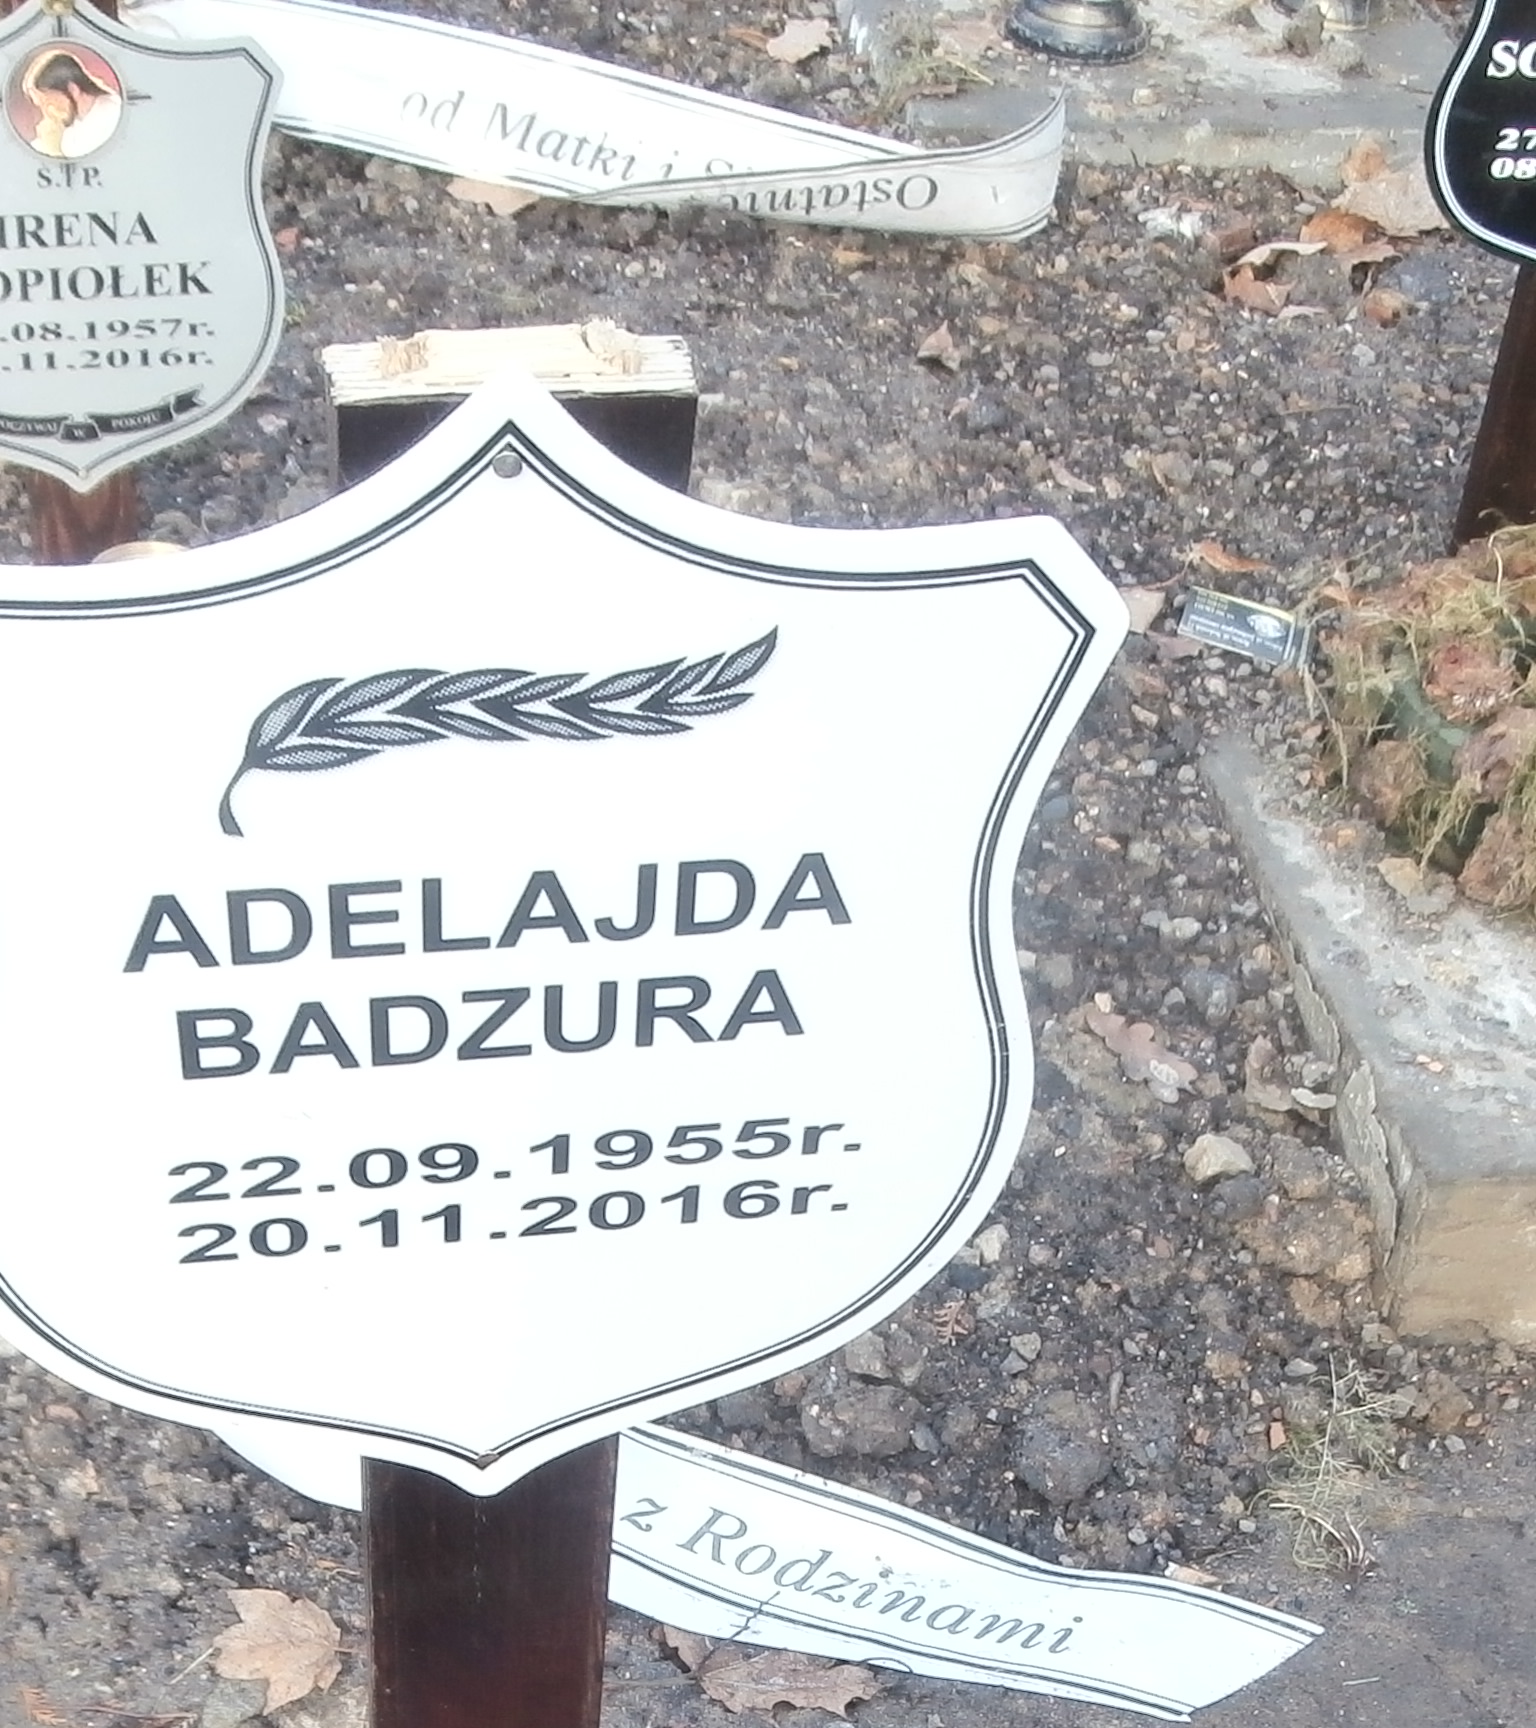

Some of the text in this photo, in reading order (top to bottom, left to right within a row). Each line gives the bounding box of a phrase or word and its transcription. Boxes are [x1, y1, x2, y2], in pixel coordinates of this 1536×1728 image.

[484, 101, 636, 181] Matki
[122, 852, 852, 973] ADELAJDA
[175, 968, 804, 1080] BADZURA
[168, 1117, 863, 1204] 22.09.1955r.
[178, 1179, 850, 1265] 20.11.2016r.
[619, 1497, 1084, 1656] z Rodzinami
